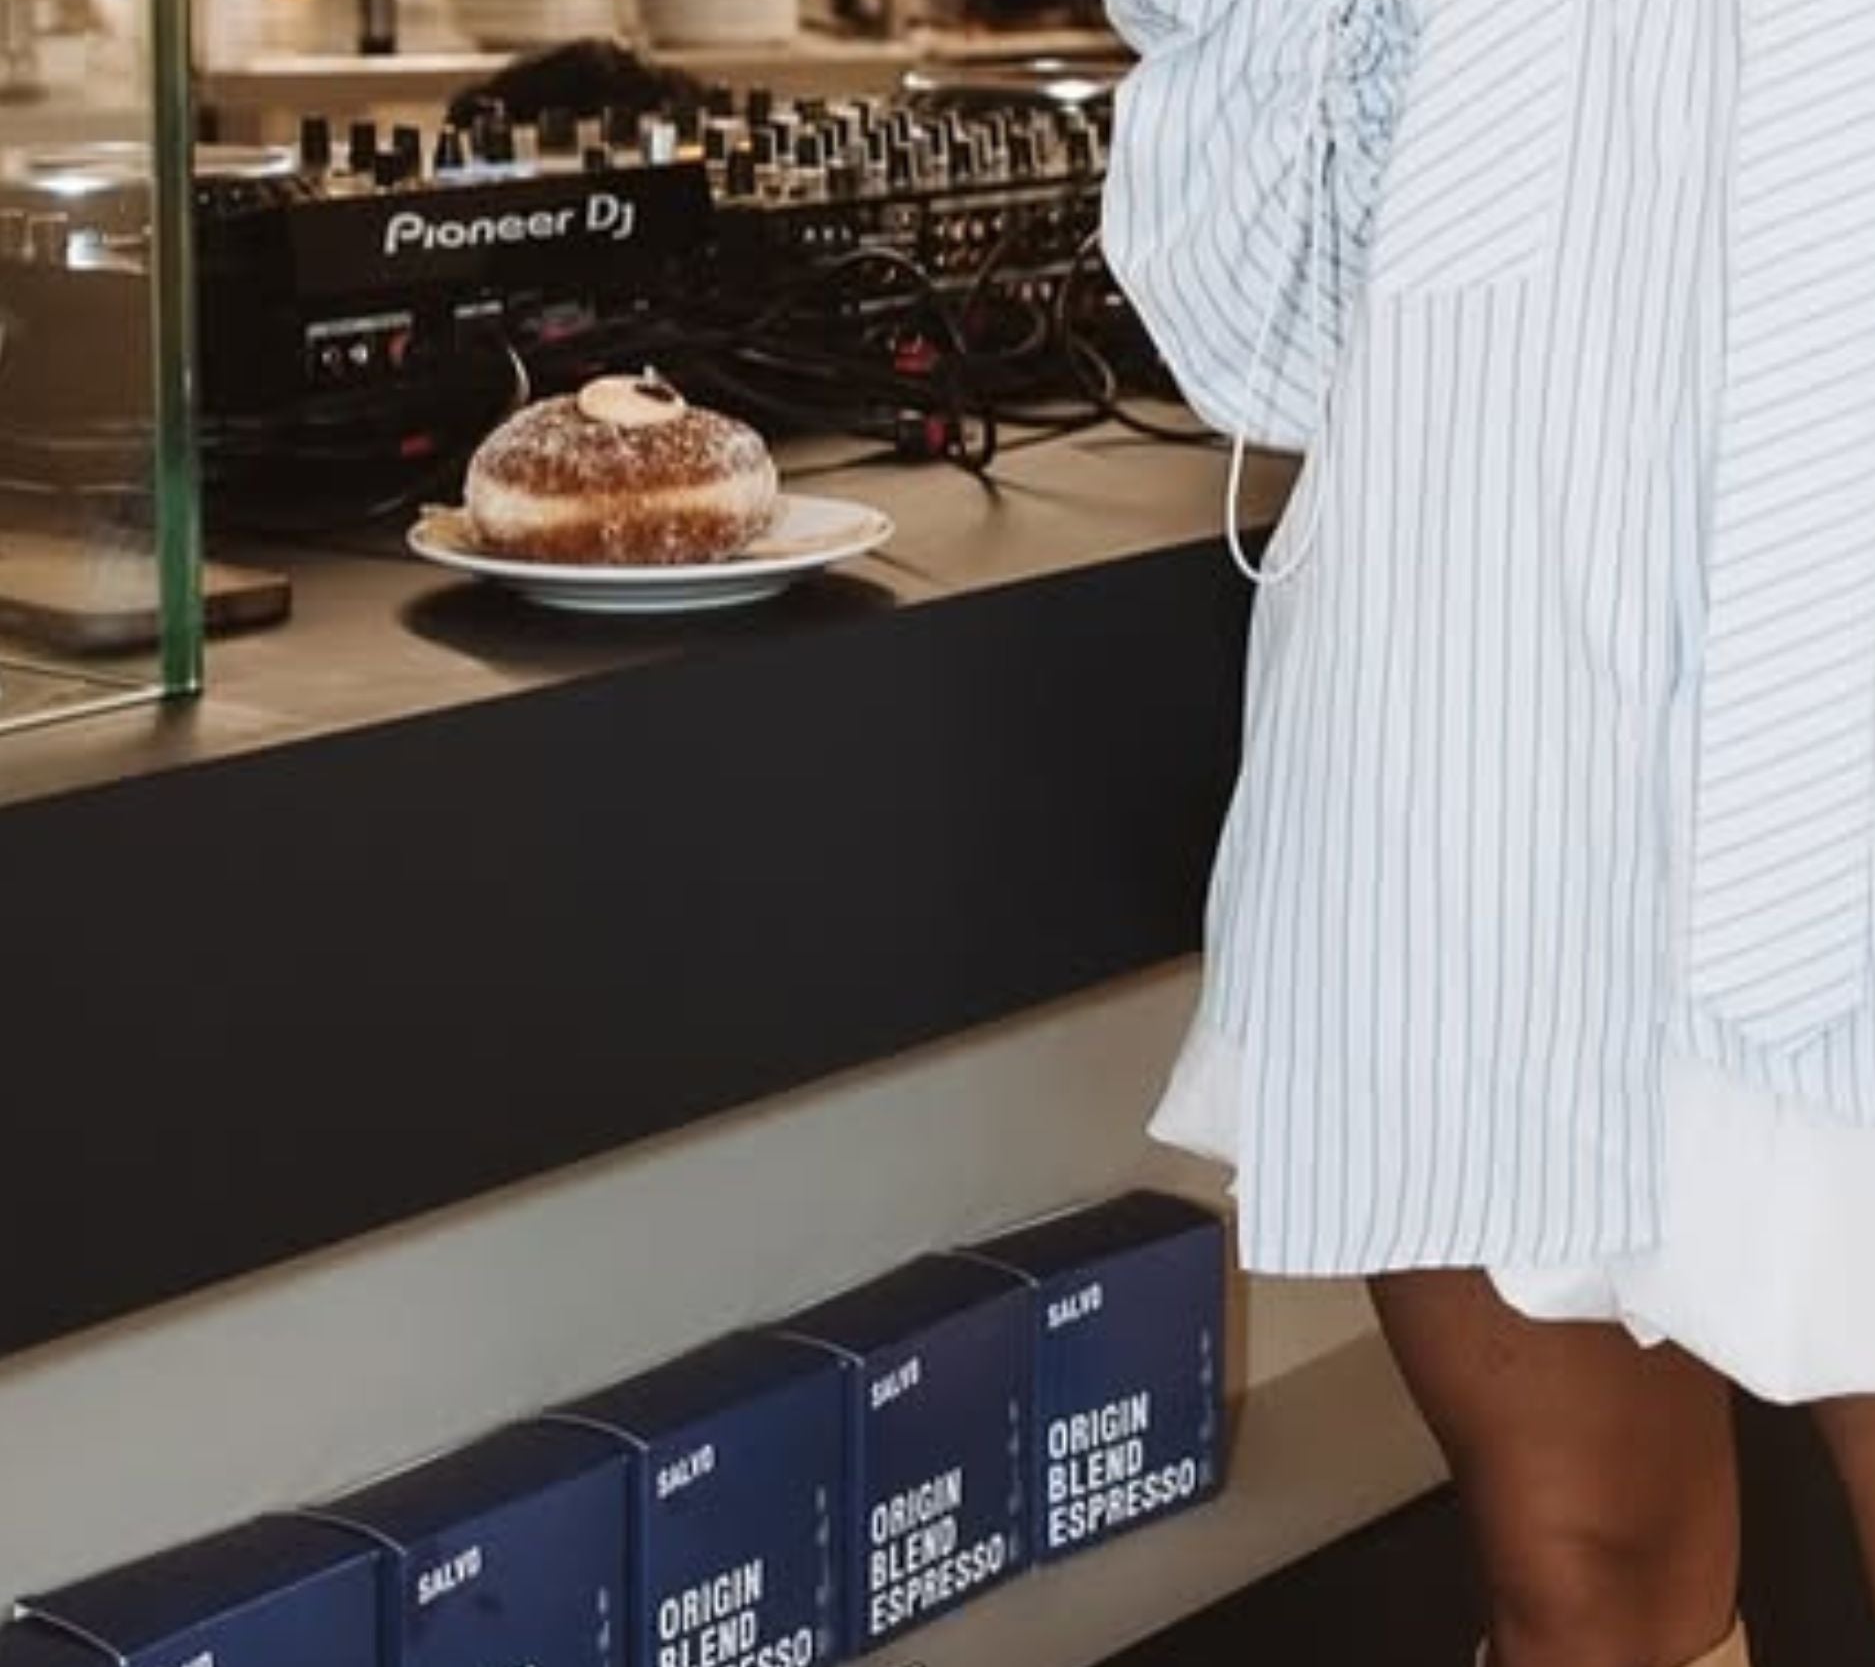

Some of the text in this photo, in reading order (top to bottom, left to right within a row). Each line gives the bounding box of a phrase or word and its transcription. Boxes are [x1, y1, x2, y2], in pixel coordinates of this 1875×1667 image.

[383, 209, 576, 256] Pioneer
[1047, 1282, 1104, 1329] SALVO
[1048, 1391, 1150, 1461] ORIGIN
[871, 1466, 962, 1545] ORIGIN
[1048, 1438, 1144, 1504] BLEND
[1048, 1458, 1196, 1548] ESPRESSO
[418, 1545, 482, 1606] SALVO
[870, 1514, 958, 1592] BLEND
[870, 1532, 1005, 1635] ESPRESSO
[659, 1557, 763, 1641] ORIGIN
